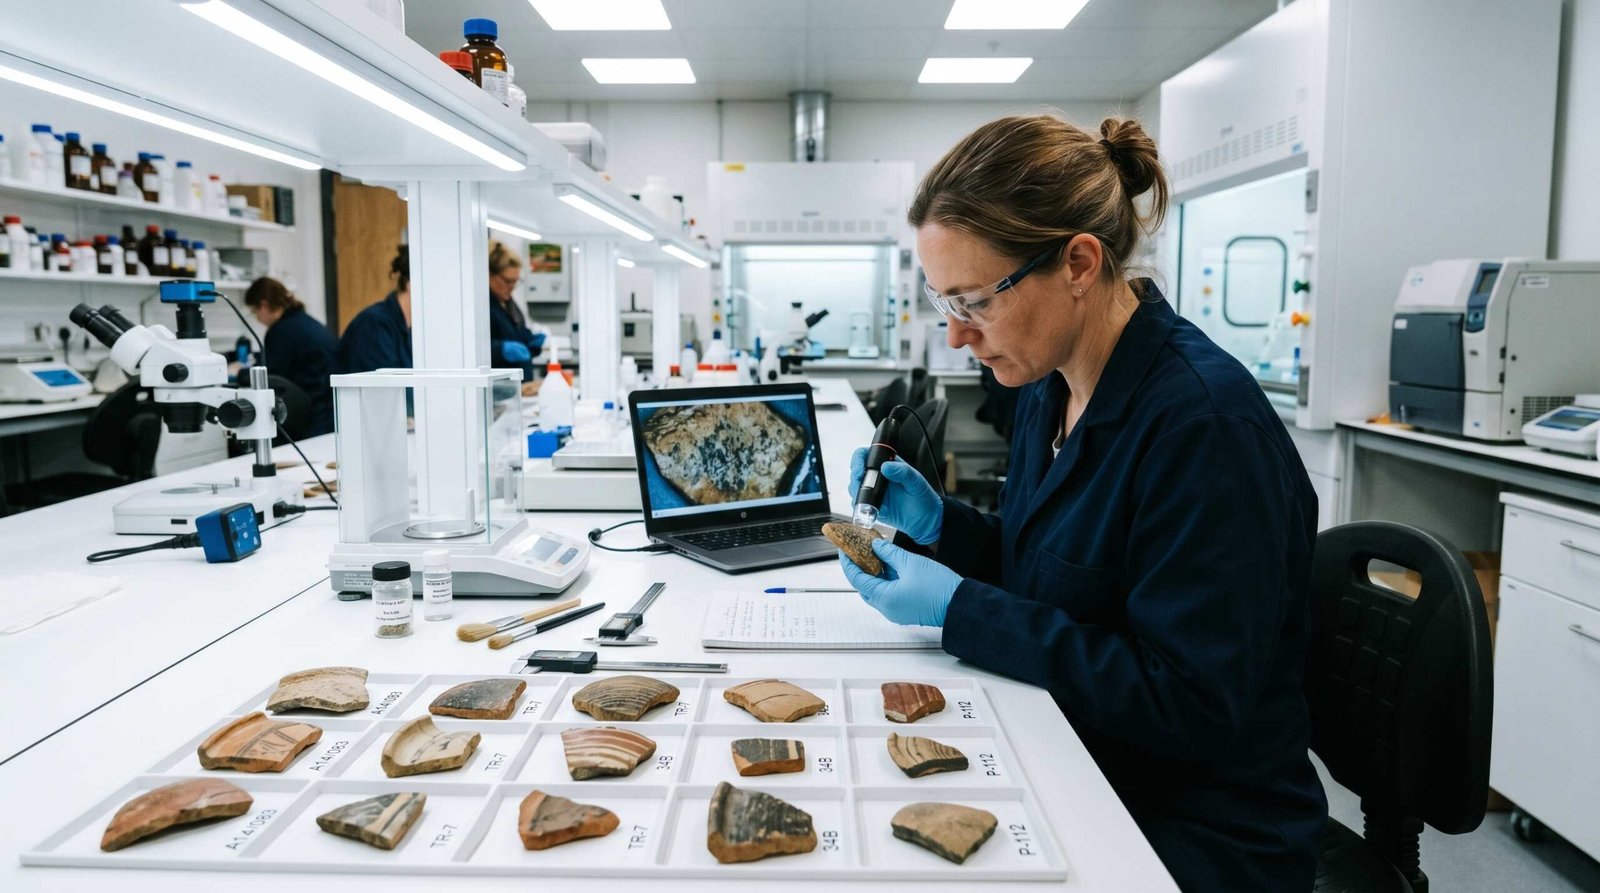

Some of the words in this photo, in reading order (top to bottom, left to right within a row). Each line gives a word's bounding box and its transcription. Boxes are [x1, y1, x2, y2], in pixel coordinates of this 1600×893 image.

[522, 700, 543, 716] TR-7
[673, 701, 690, 717] TR-7
[958, 701, 976, 719] P-112
[309, 740, 349, 772] A14/083
[484, 752, 508, 773] TR-7
[655, 755, 674, 771] 34B
[818, 757, 834, 773] 34B
[979, 753, 1002, 777] P-112
[225, 808, 278, 851] A14/083
[429, 824, 458, 849] TR-7
[627, 824, 648, 850] TR-7
[1009, 824, 1037, 856] P-112
[822, 830, 839, 852] 34B
